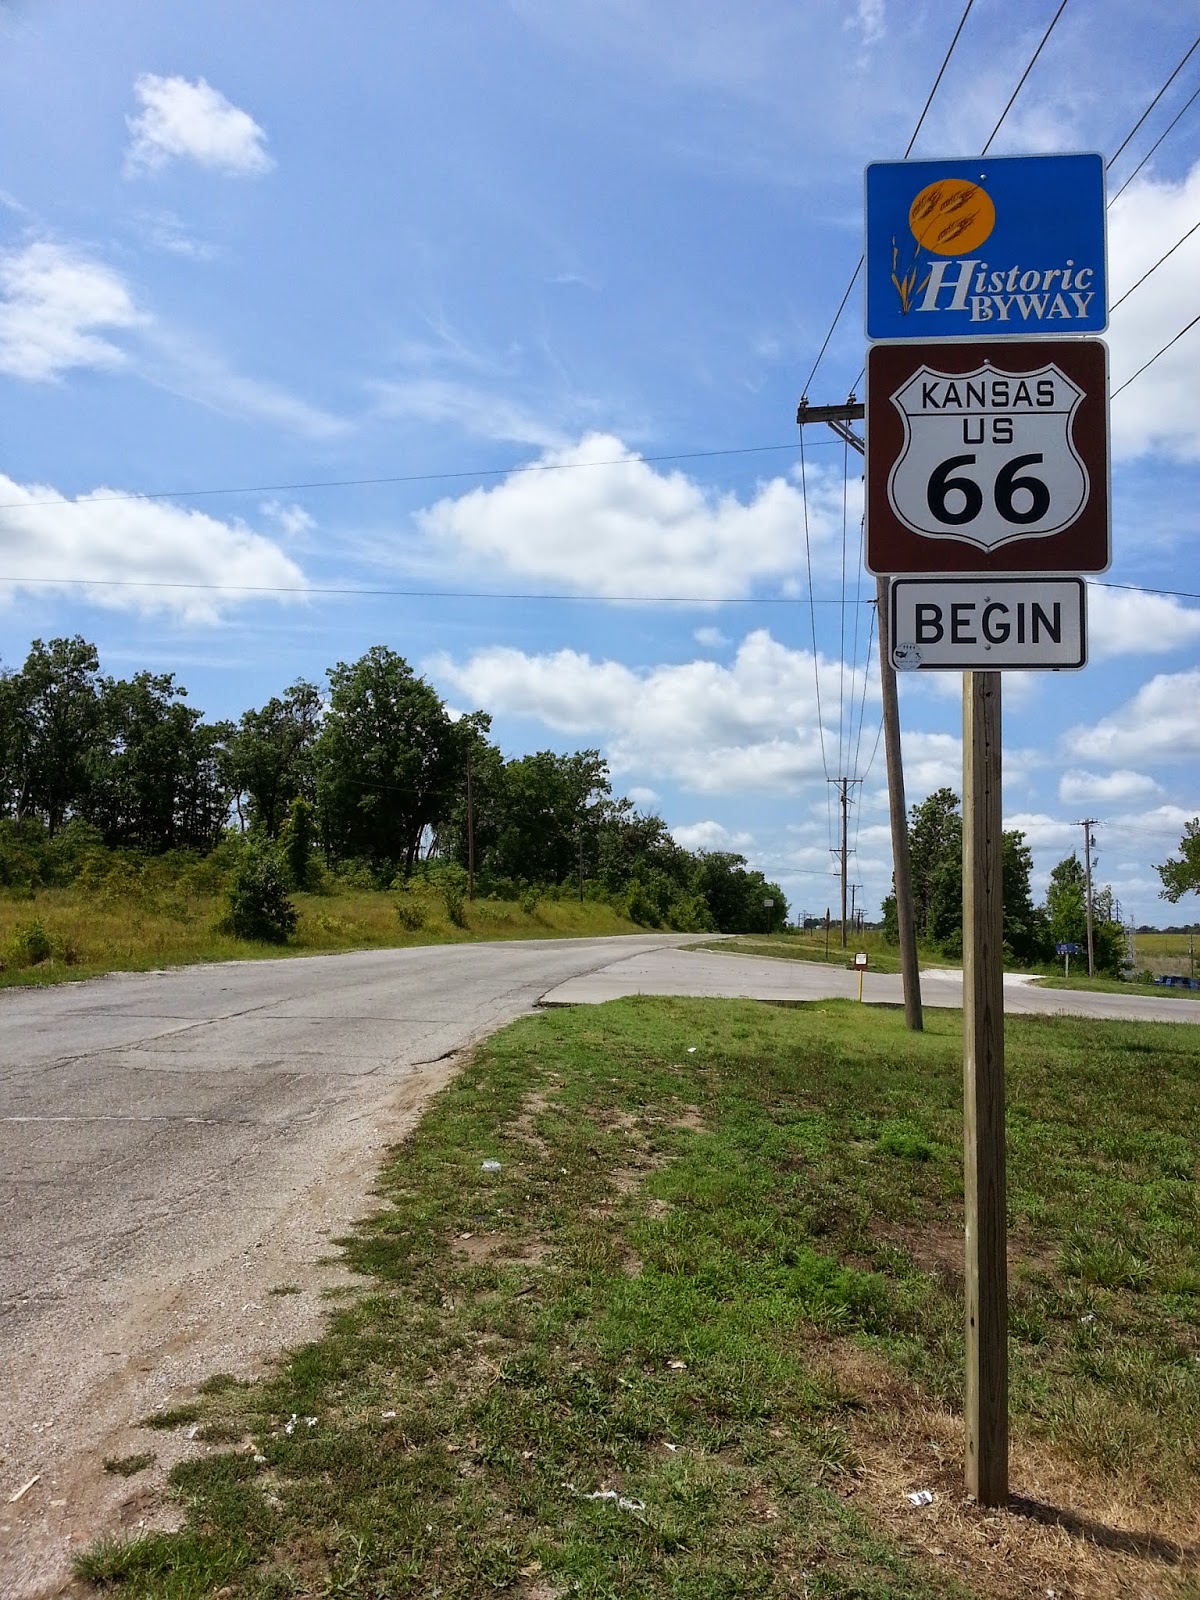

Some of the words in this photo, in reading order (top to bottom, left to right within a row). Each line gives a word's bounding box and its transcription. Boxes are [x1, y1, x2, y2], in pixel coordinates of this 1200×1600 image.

[915, 259, 1094, 312] Historic
[969, 291, 1095, 322] BYWAY
[922, 380, 1055, 409] KANSAS
[963, 417, 1014, 444] US
[927, 453, 1050, 525] 66
[915, 602, 1061, 644] BEGIN
